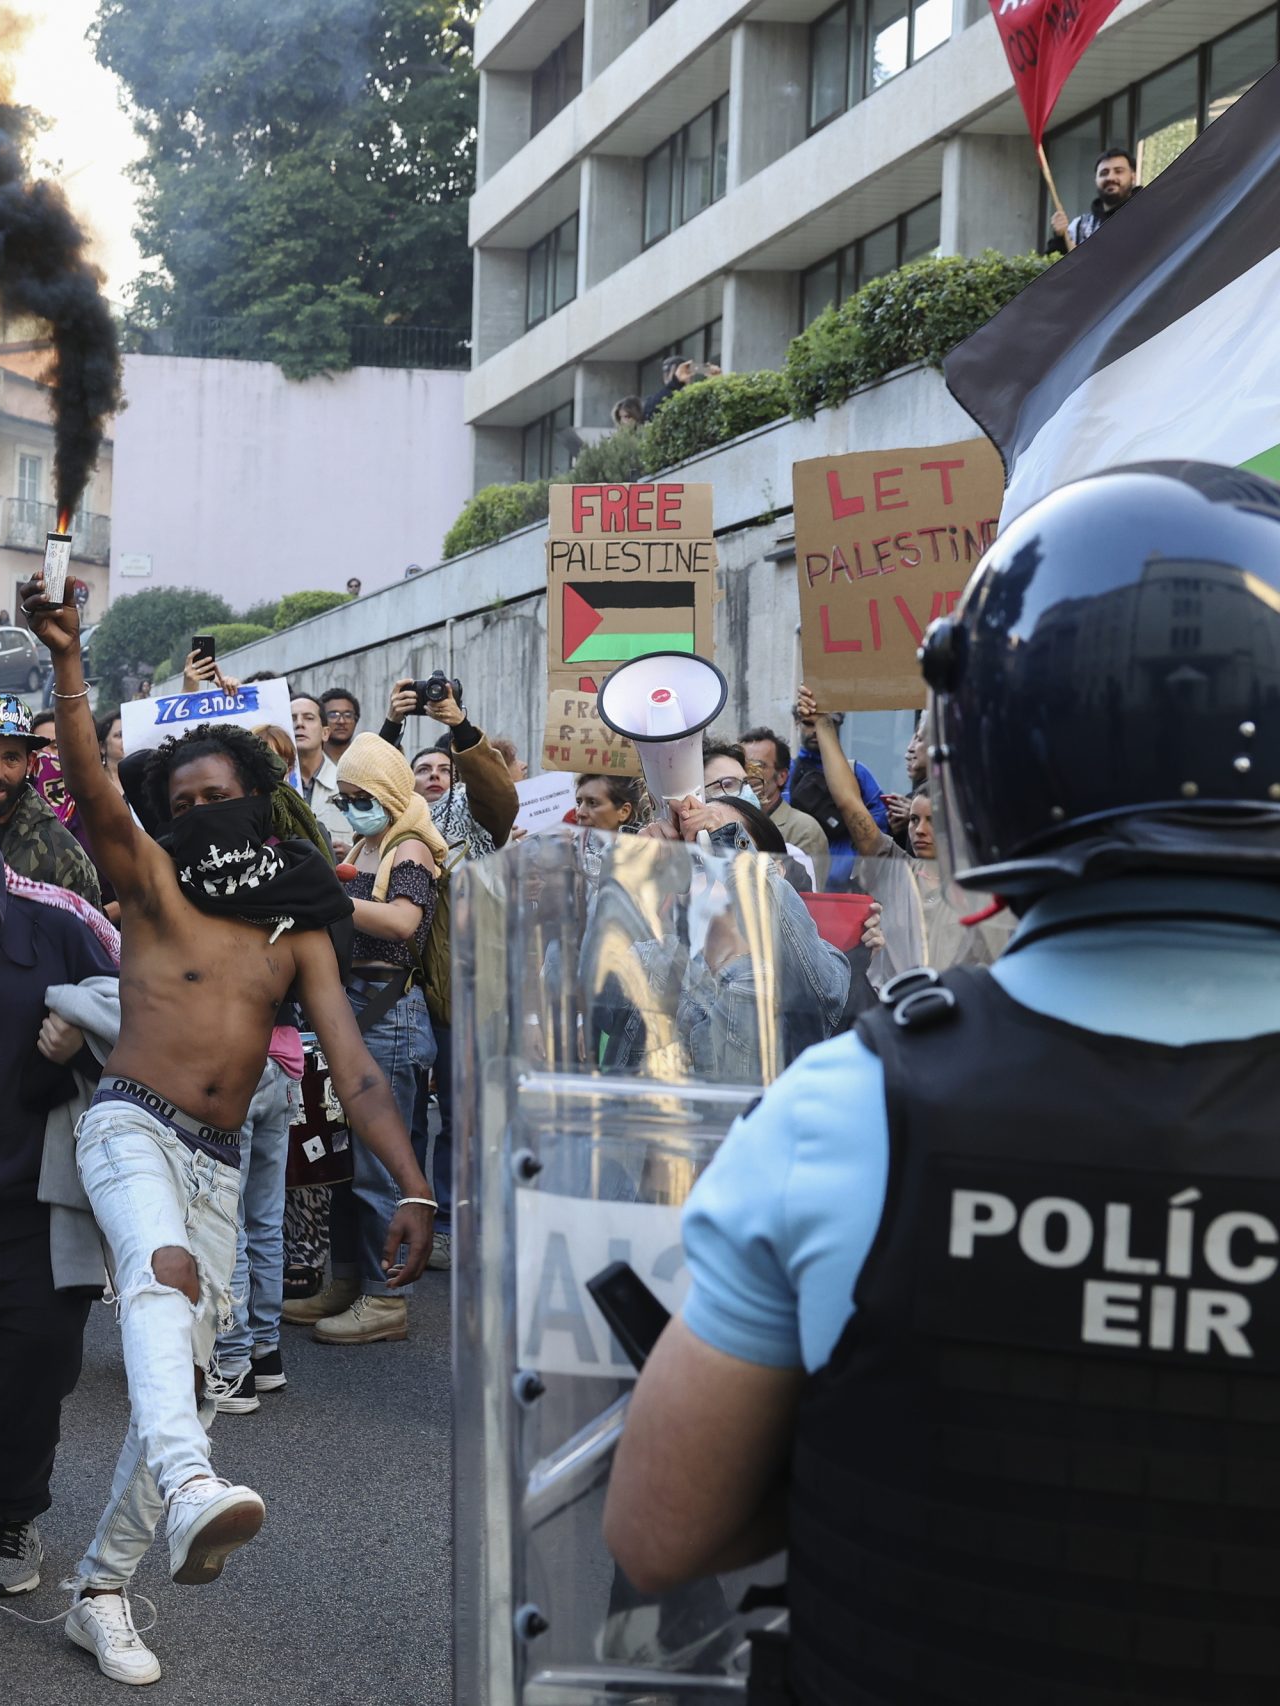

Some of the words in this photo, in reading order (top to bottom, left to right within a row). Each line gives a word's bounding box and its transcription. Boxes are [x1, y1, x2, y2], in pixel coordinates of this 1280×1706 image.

[826, 459, 964, 521] LET
[572, 484, 684, 533] FREE
[551, 541, 712, 573] PALESTINE
[162, 698, 190, 720] 76
[198, 693, 245, 715] anos
[564, 700, 600, 719] FRO
[560, 725, 631, 748] RIVE
[545, 745, 570, 761] TO
[1081, 1279, 1253, 1357] EIR
